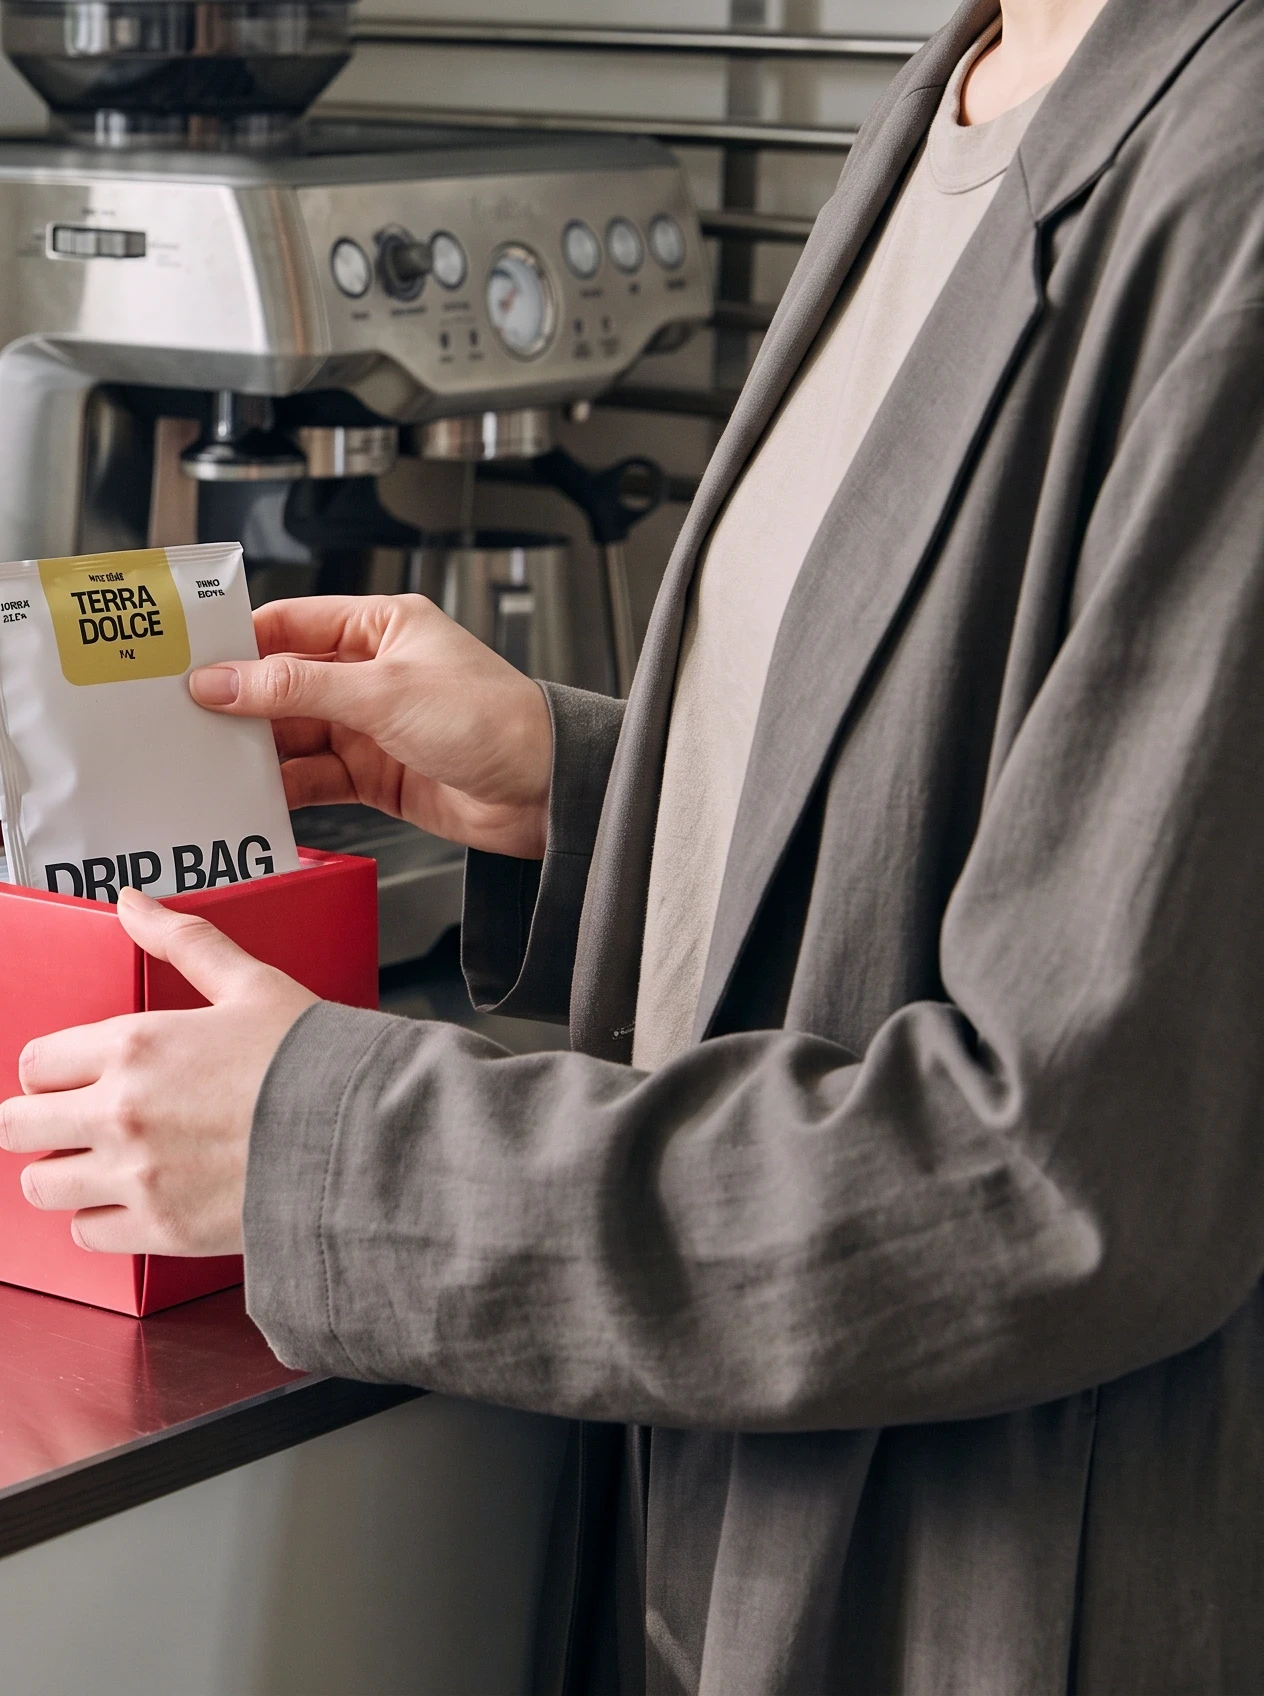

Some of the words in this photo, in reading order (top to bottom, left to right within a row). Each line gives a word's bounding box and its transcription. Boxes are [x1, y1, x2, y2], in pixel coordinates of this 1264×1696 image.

[70, 585, 157, 615] TERRA
[79, 610, 164, 645] DOLCE
[44, 850, 162, 905] DRIP
[171, 834, 275, 894] BAG
